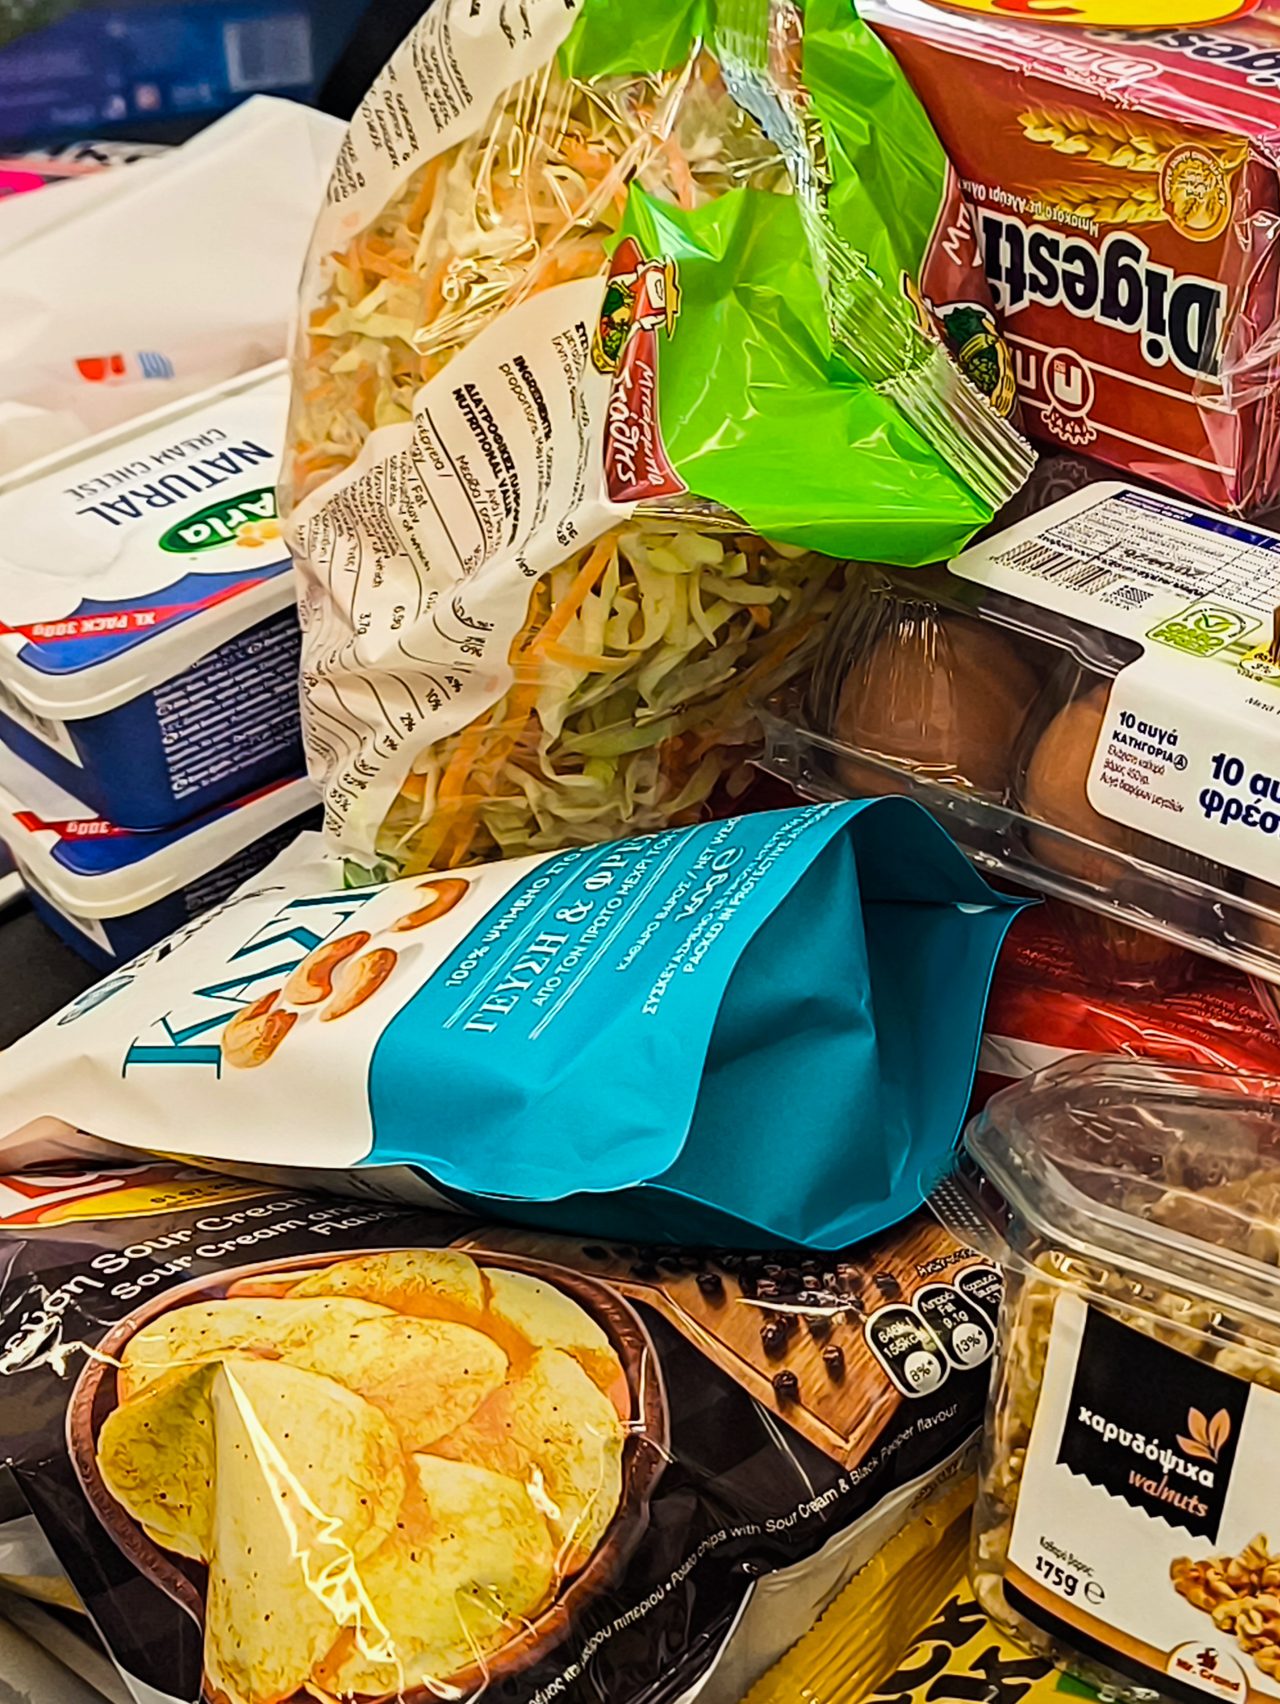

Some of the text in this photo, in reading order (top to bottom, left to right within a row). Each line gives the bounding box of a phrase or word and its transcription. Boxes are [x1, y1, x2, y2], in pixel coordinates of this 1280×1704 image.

[982, 214, 1222, 379] Digesti
[452, 387, 503, 480] NUTRITIONAL
[63, 428, 227, 502] CREAM CHEESE
[76, 440, 275, 526] NATURAL
[177, 492, 277, 544] Arla
[32, 612, 156, 637] XL PACK 300g
[1112, 730, 1174, 763] ΚΑΤΗΓΟΡΙΑ
[1119, 711, 1178, 746] 10 αυγά
[1210, 752, 1245, 787] 10
[66, 821, 111, 835] 300g
[445, 944, 490, 987] 100%
[482, 876, 551, 942] ΨΗΜΕΝΟ
[531, 976, 562, 1007] ΑΠΟ
[556, 945, 586, 975] ΤΟΝ
[616, 858, 652, 896] ΜΕΧΡΙ
[683, 920, 724, 973] PACKED
[462, 931, 570, 1034] ΓΕΥΣΗ
[554, 900, 594, 923] &
[91, 1229, 193, 1274] Sour
[111, 1256, 192, 1300] Sour
[196, 1217, 308, 1258] Cream
[729, 1523, 761, 1538] with
[765, 1511, 798, 1533] Sour
[798, 1487, 839, 1518] Cream
[838, 1478, 850, 1494] &
[916, 1402, 960, 1432] flavour
[1078, 1406, 1216, 1489] καρυδόψιχα
[1128, 1470, 1209, 1518] walnuts
[1035, 1556, 1079, 1597] 175g
[613, 1584, 666, 1631] πιπεριού
